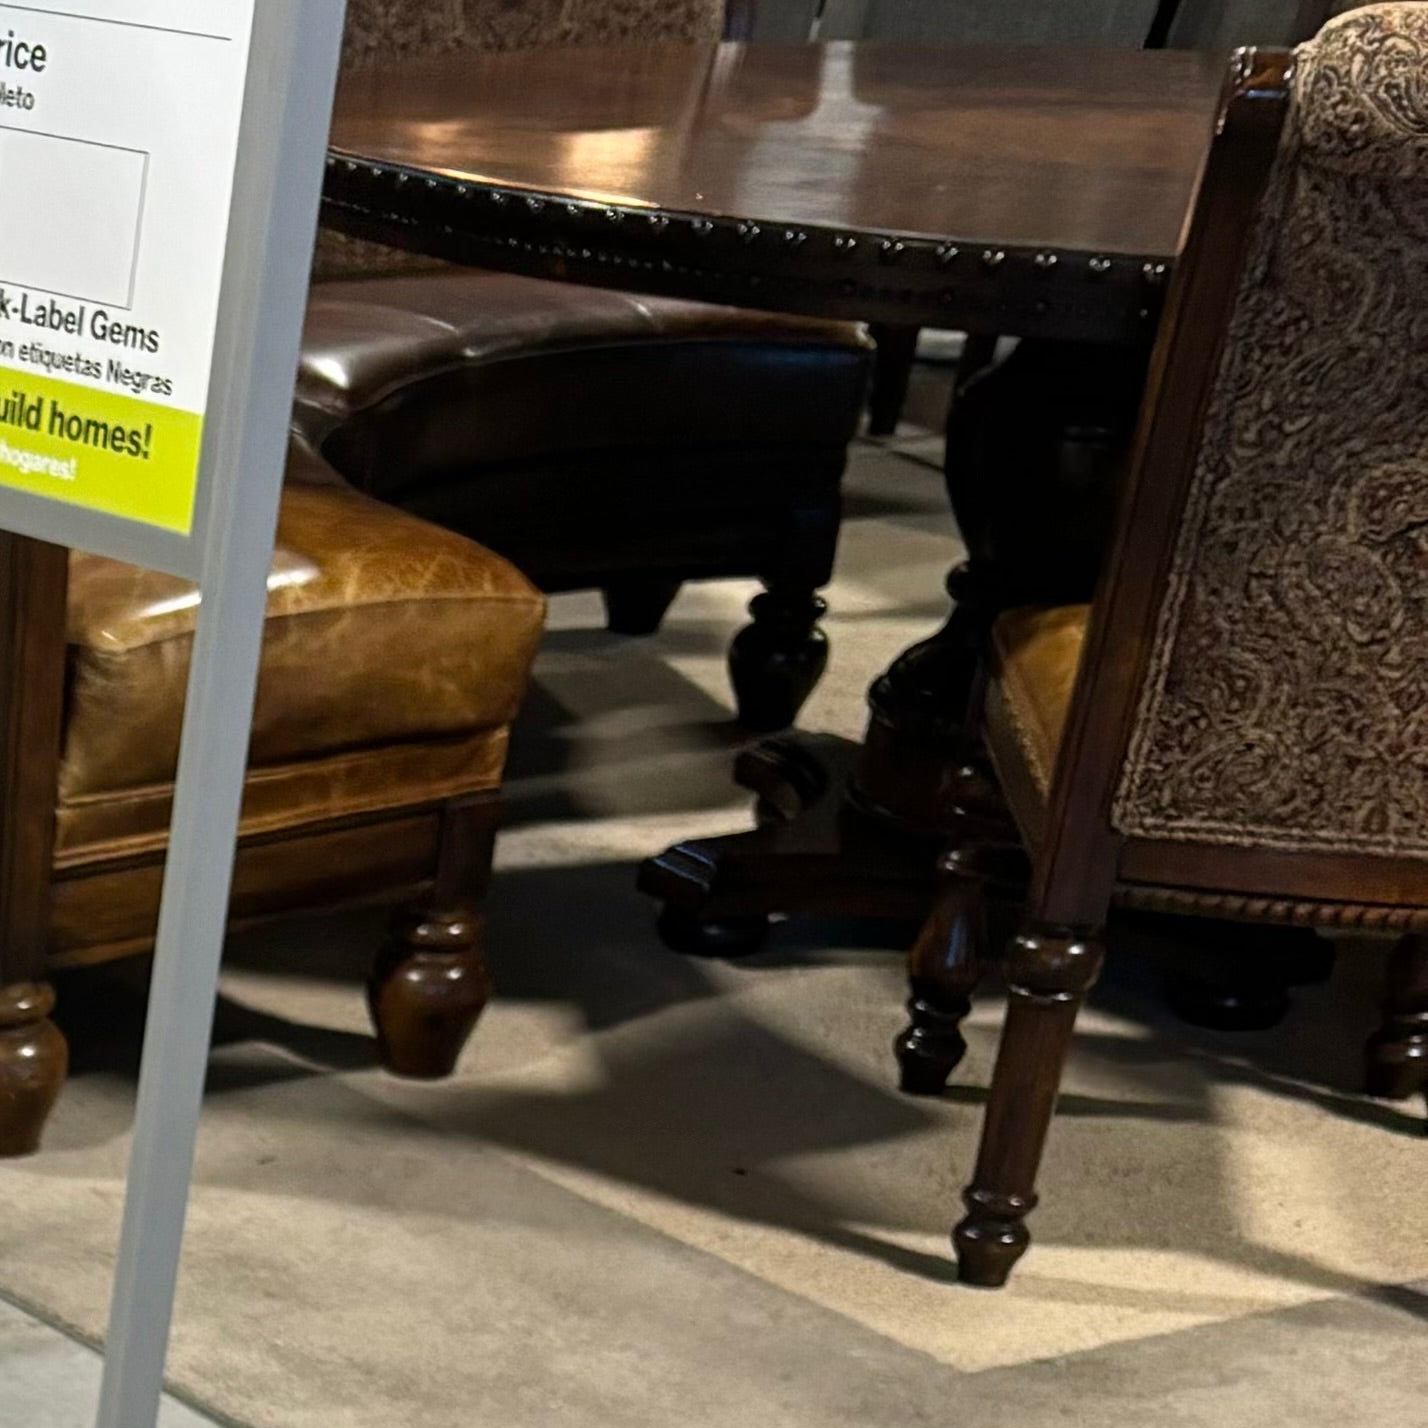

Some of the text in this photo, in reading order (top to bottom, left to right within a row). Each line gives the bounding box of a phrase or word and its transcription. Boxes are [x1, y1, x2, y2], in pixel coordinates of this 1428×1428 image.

[90, 309, 159, 353] Gems
[18, 341, 101, 379] etiquetas
[106, 358, 173, 396] Negras
[48, 400, 152, 459] homes!
